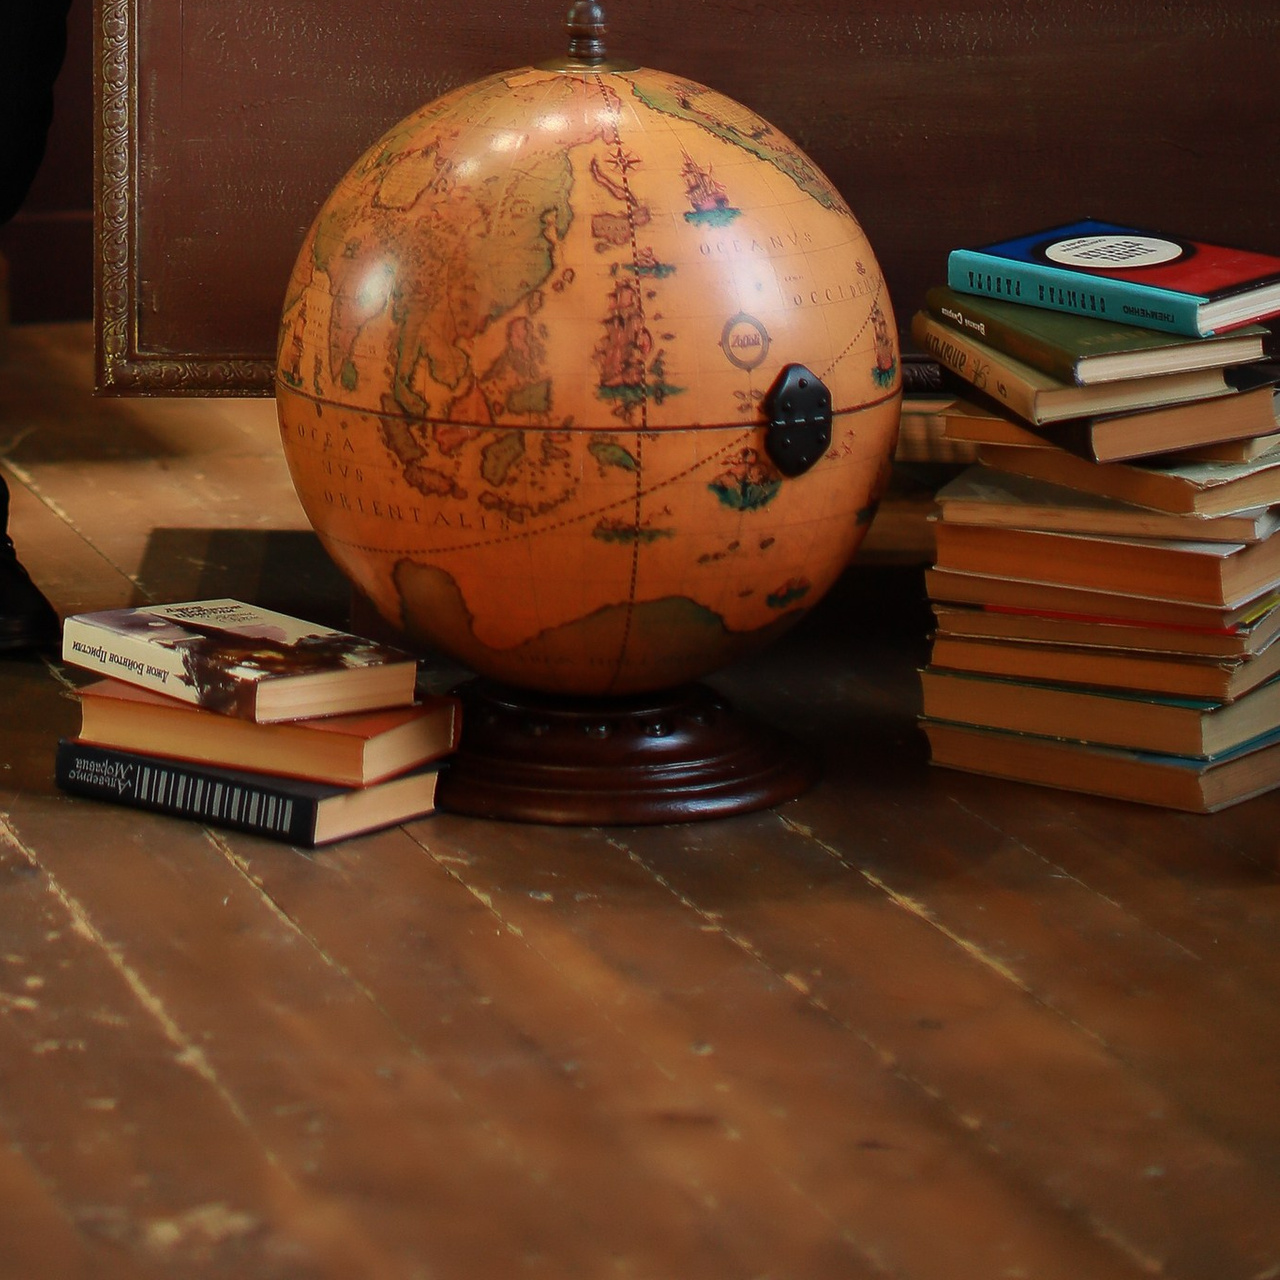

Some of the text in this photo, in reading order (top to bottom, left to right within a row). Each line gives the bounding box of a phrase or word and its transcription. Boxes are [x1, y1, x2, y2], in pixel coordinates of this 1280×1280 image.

[1037, 284, 1106, 312] СКРЫТАЯ
[72, 641, 107, 664] Пристли
[146, 665, 170, 684] Джон
